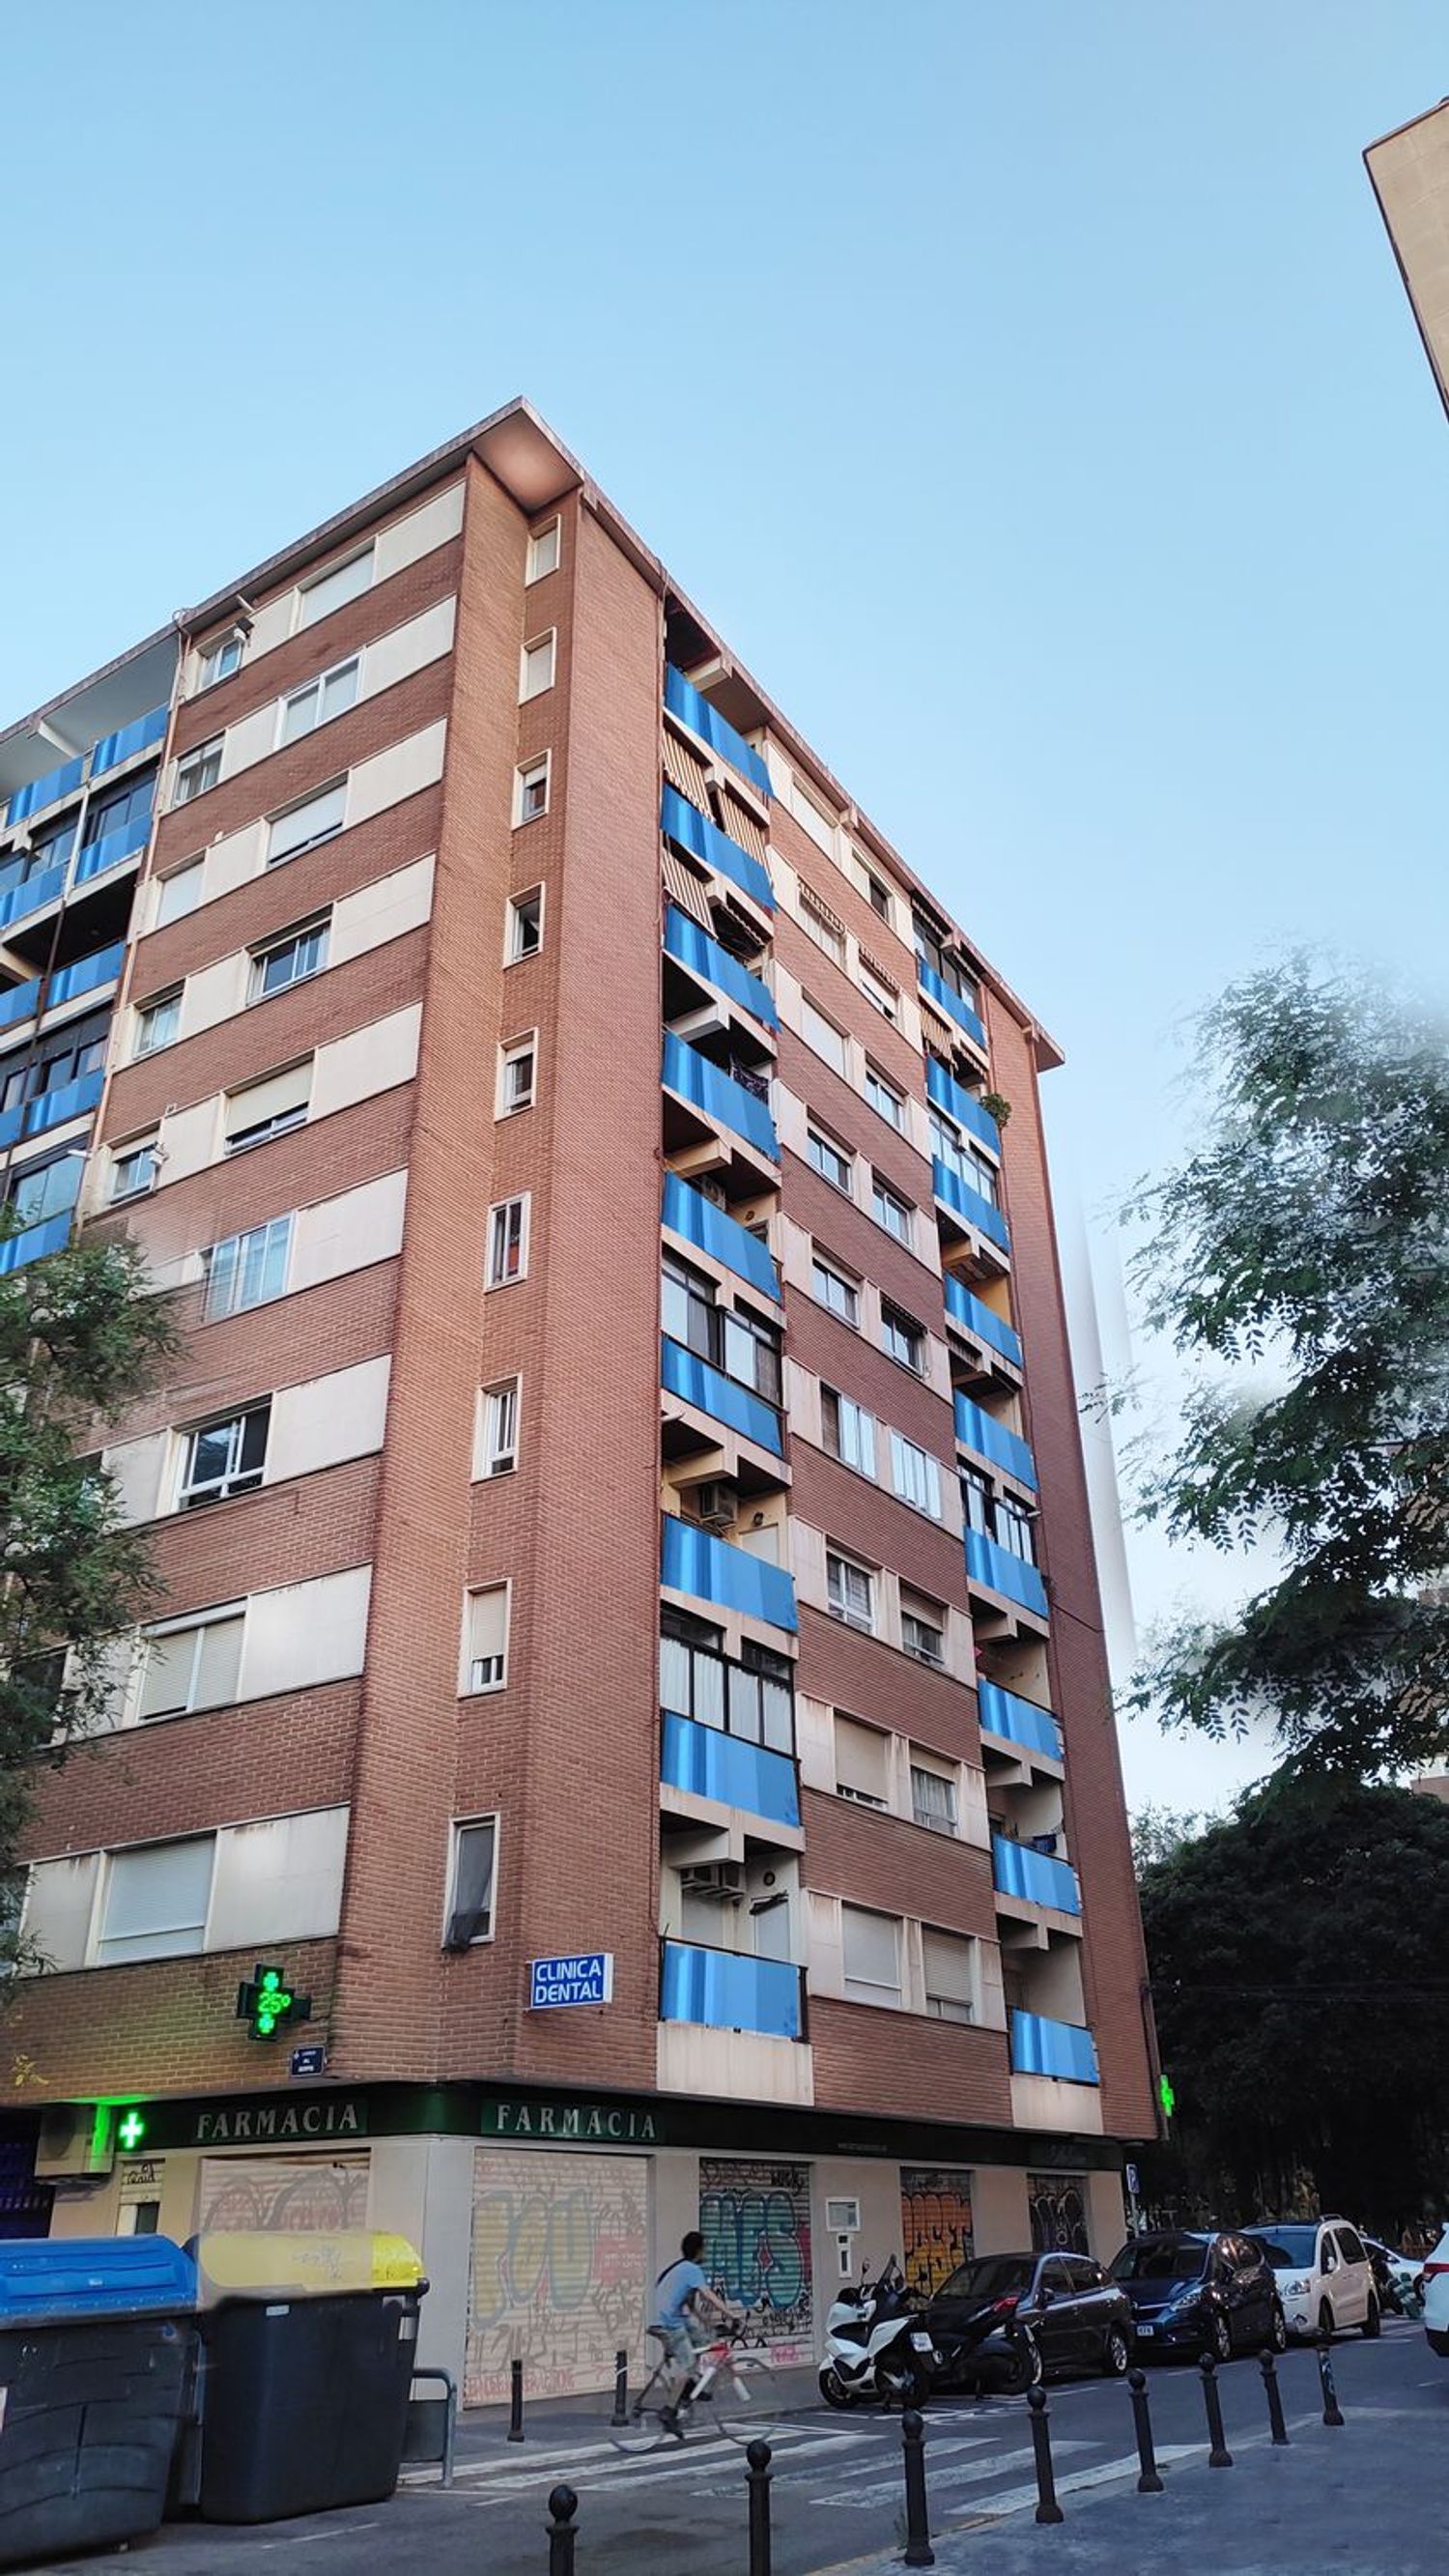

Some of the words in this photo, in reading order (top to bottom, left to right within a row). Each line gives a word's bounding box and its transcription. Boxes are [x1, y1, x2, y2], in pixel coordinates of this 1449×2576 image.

[536, 1959, 602, 1982] CLINICA
[534, 1980, 601, 2004] DENTAL
[196, 2104, 358, 2139] FARMACIA
